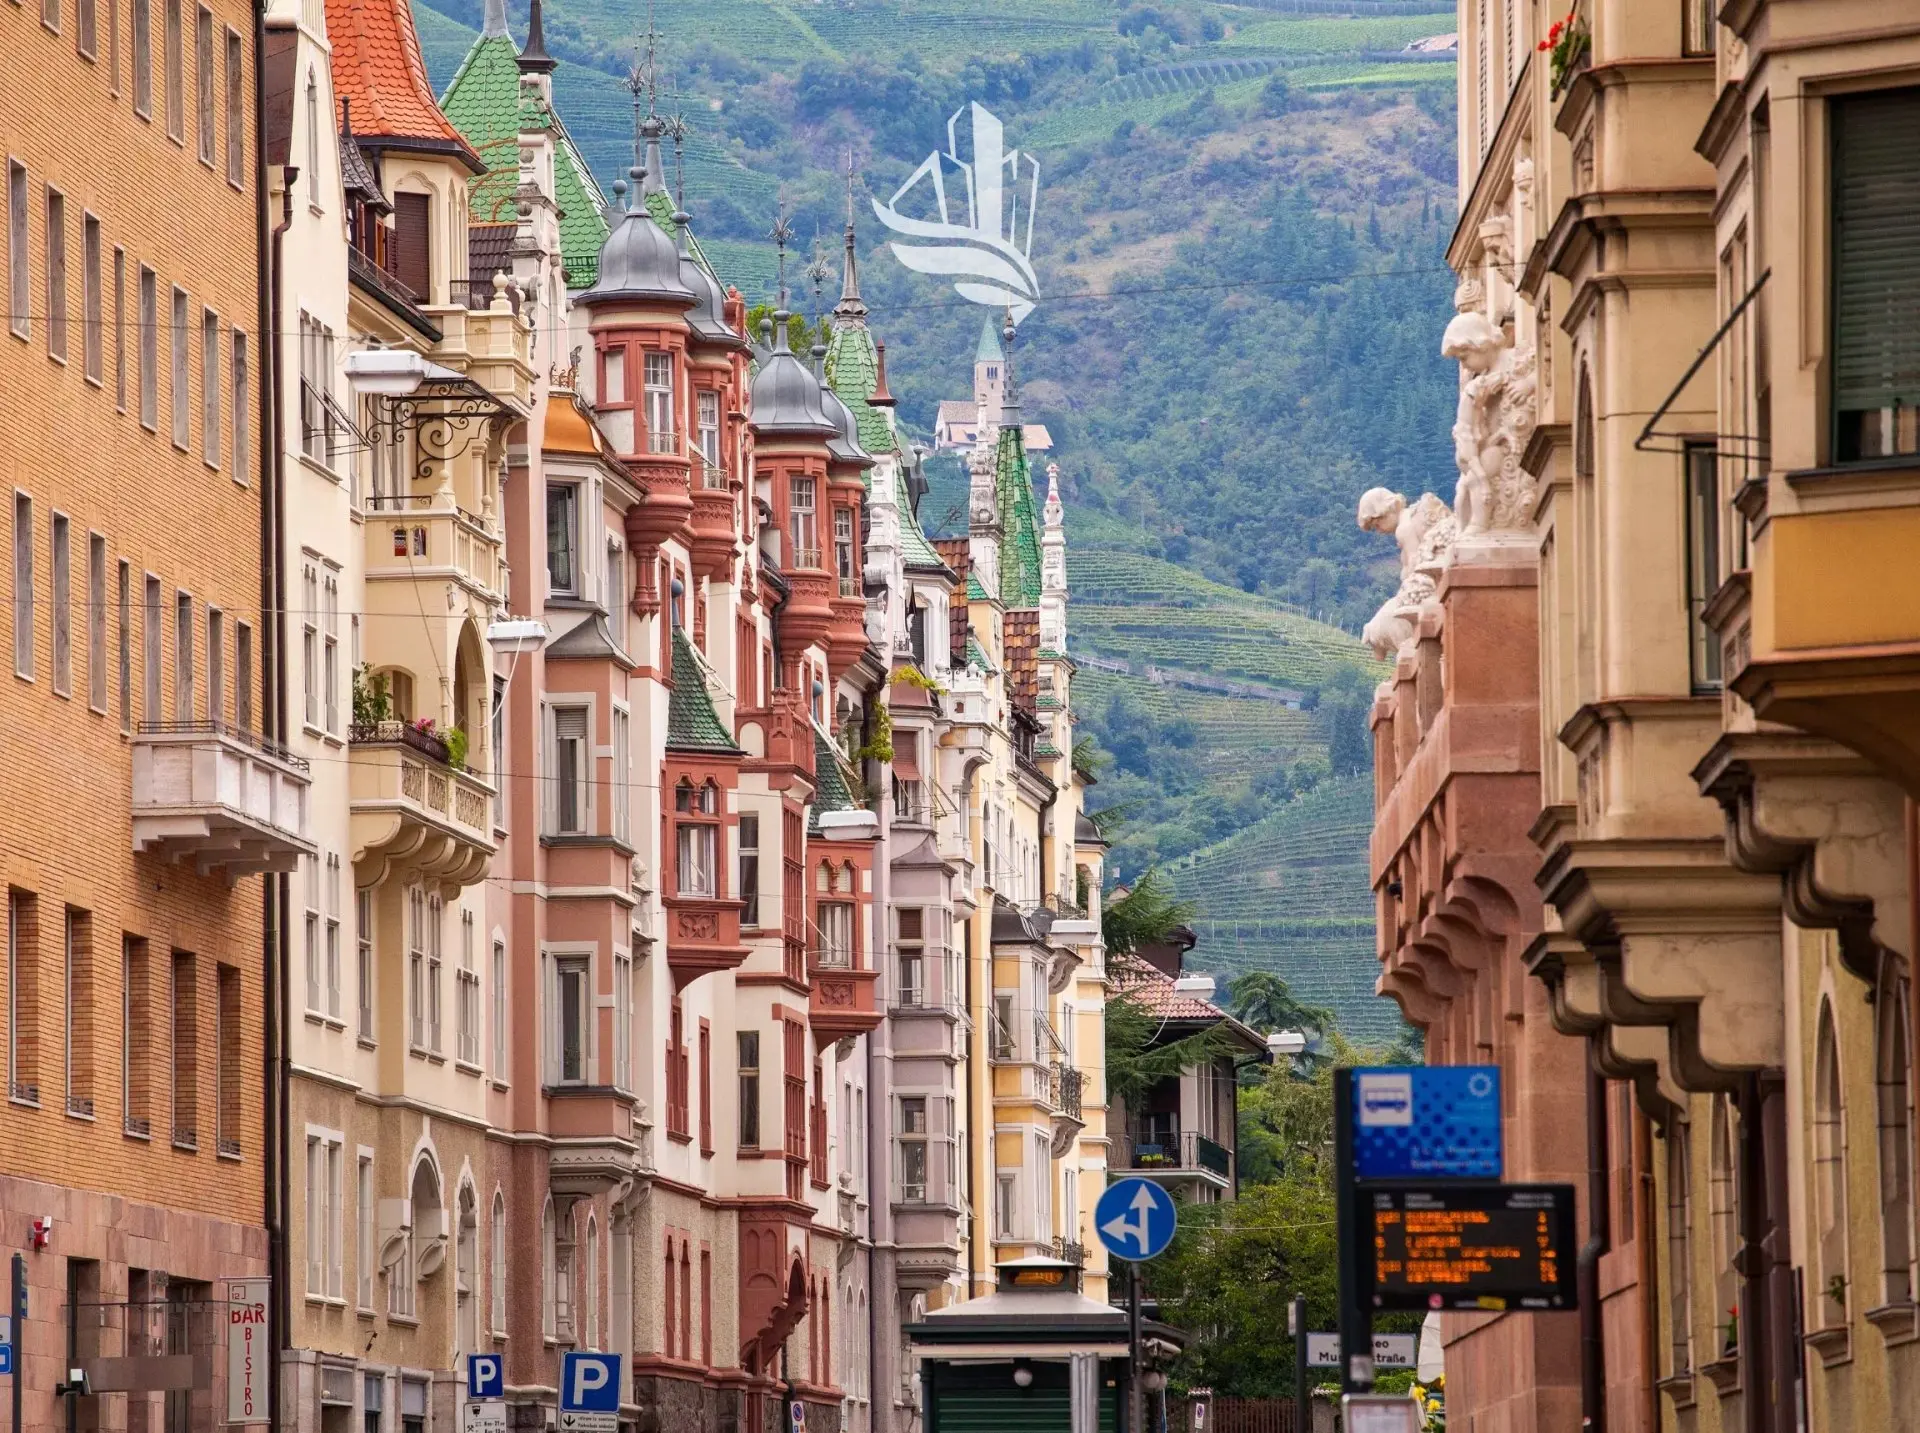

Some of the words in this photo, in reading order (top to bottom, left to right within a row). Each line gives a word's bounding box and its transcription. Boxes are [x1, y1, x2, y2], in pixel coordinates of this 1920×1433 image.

[231, 1303, 265, 1324] BAR
[244, 1327, 253, 1416] BISTRO
[475, 1358, 497, 1394] P
[573, 1358, 609, 1405] P
